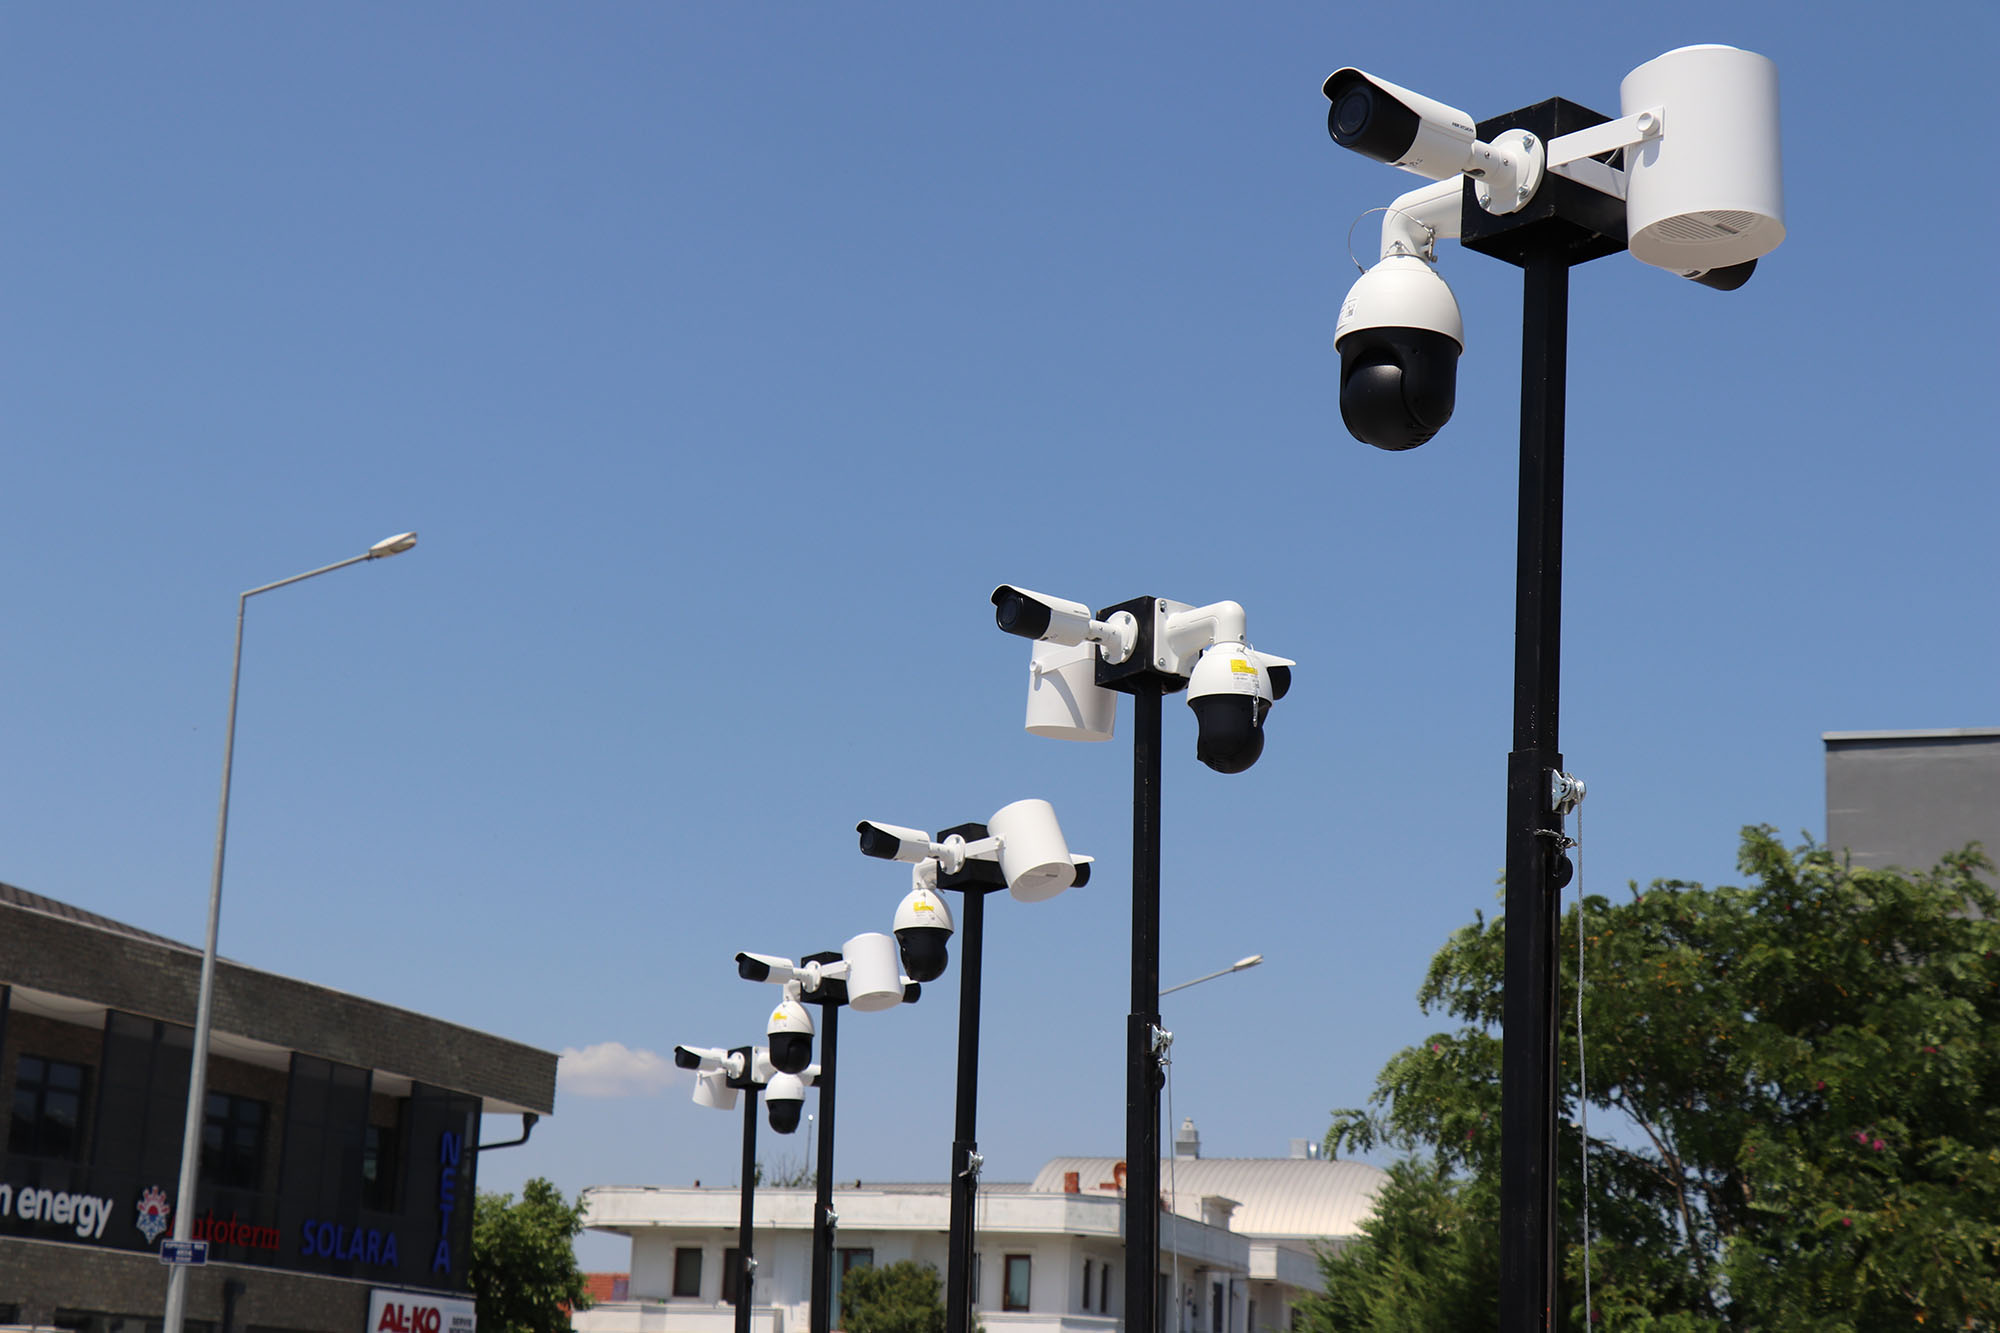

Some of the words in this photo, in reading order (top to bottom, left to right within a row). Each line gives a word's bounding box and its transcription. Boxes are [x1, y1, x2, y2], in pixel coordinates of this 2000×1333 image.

[17, 1186, 114, 1239] energy
[433, 1130, 461, 1273] NETA
[302, 1218, 400, 1267] SOLARA
[378, 1303, 441, 1333] AL-KO
